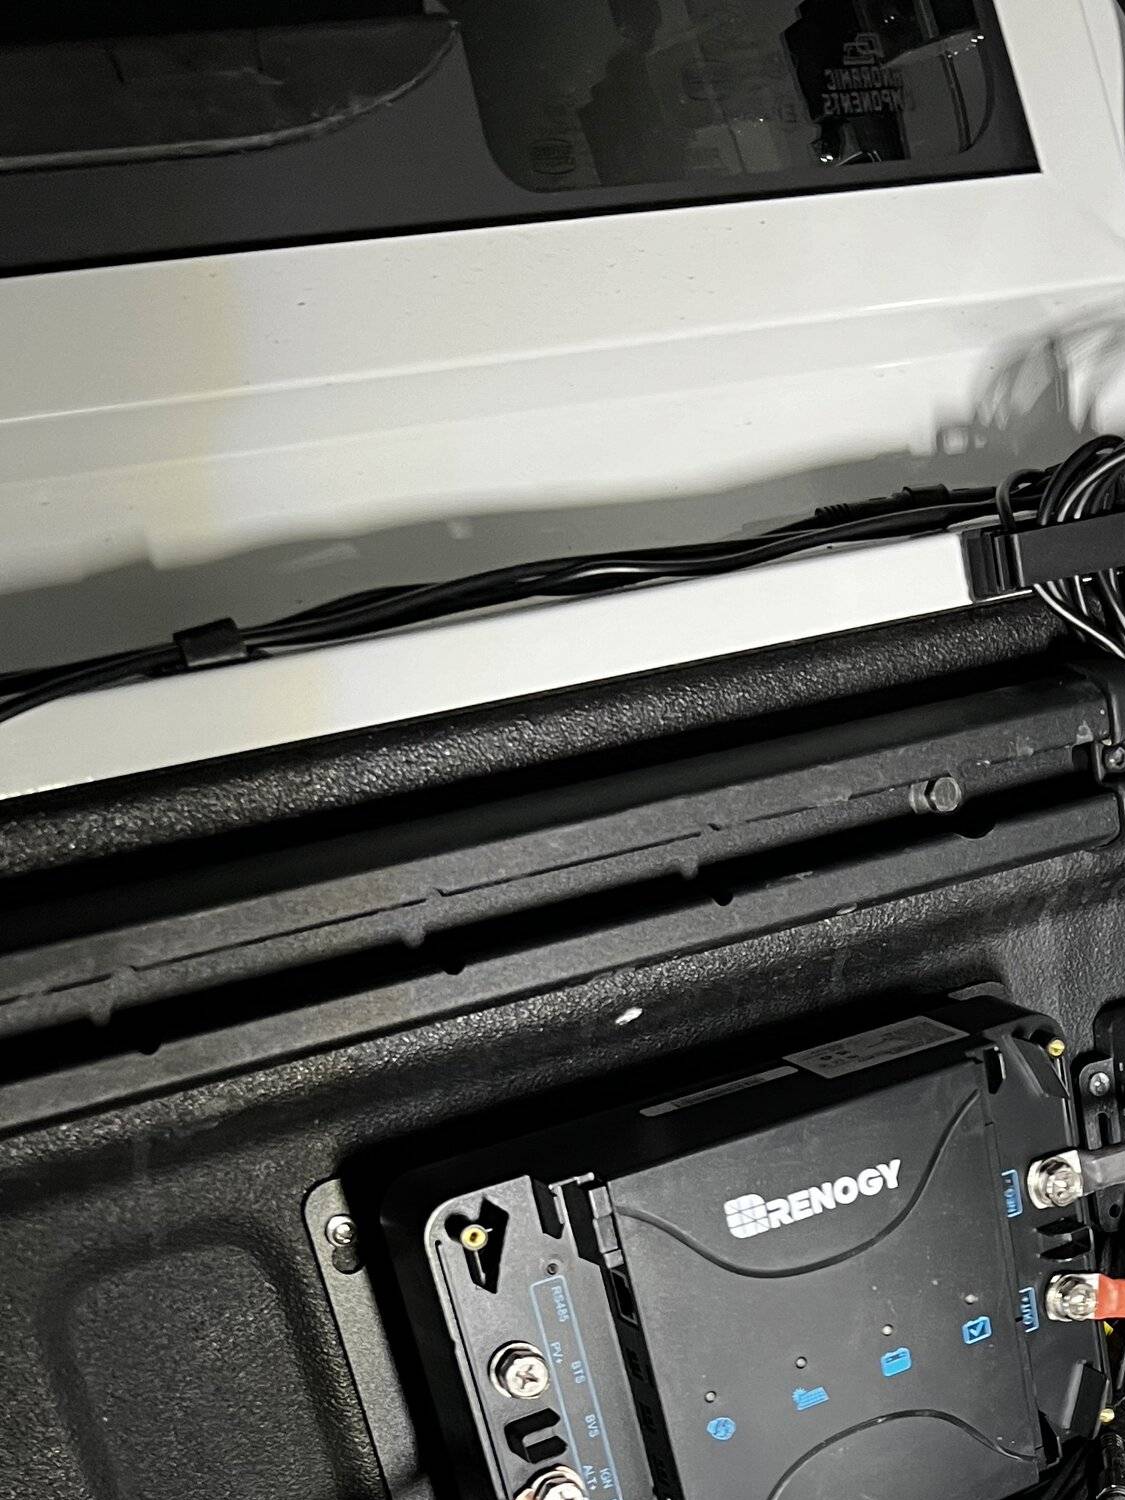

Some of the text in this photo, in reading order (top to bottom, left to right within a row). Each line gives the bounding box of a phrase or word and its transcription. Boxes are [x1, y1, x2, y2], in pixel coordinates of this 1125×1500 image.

[766, 1159, 901, 1229] RENOGY
[551, 1285, 569, 1322] RS485
[550, 1342, 563, 1364] PV+
[571, 1360, 586, 1384] BTS
[585, 1414, 600, 1438] BVS
[582, 1465, 598, 1490] ALT+
[600, 1467, 614, 1489] IGN
